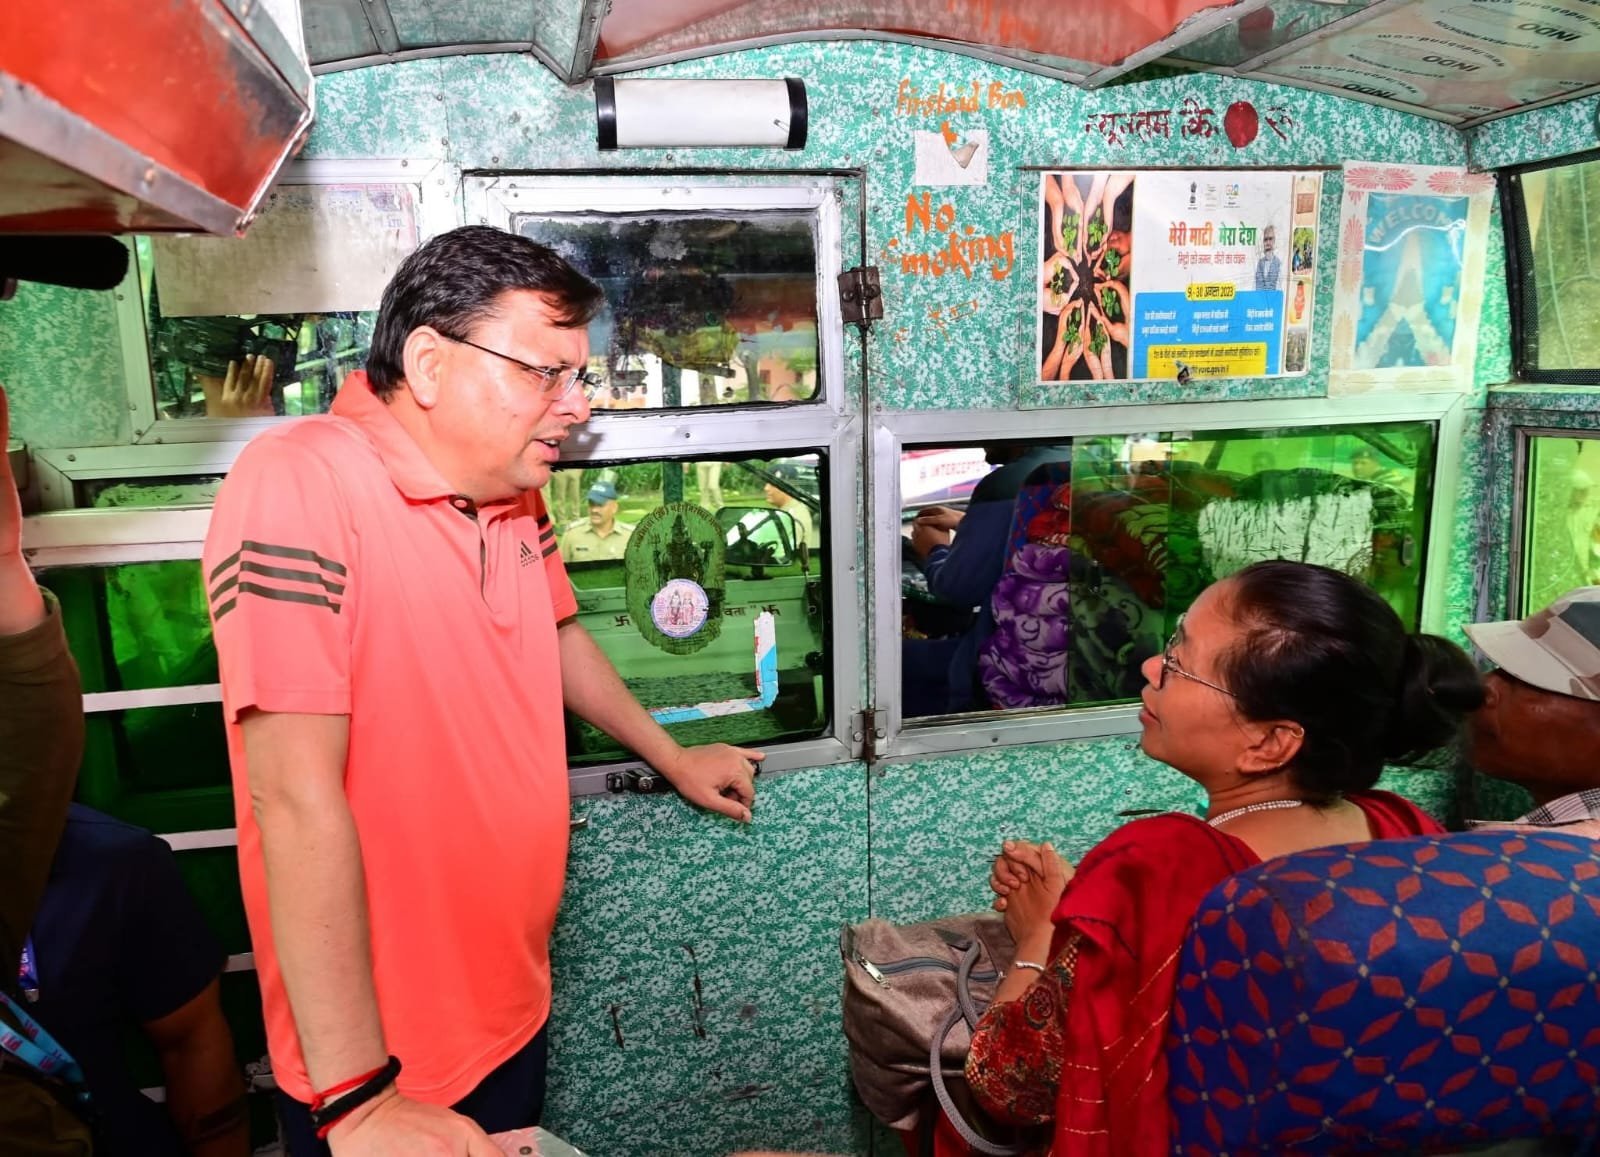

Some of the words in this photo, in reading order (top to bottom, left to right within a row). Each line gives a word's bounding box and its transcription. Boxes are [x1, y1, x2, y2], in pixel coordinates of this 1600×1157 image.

[1518, 23, 1582, 42] INDO
[1422, 54, 1480, 72] INDO
[905, 191, 955, 237] No
[1168, 221, 1187, 246] मेरी
[1189, 220, 1215, 246] माटी
[1218, 221, 1237, 246] मेरा
[1239, 220, 1258, 246] देश
[1220, 286, 1233, 297] 2023
